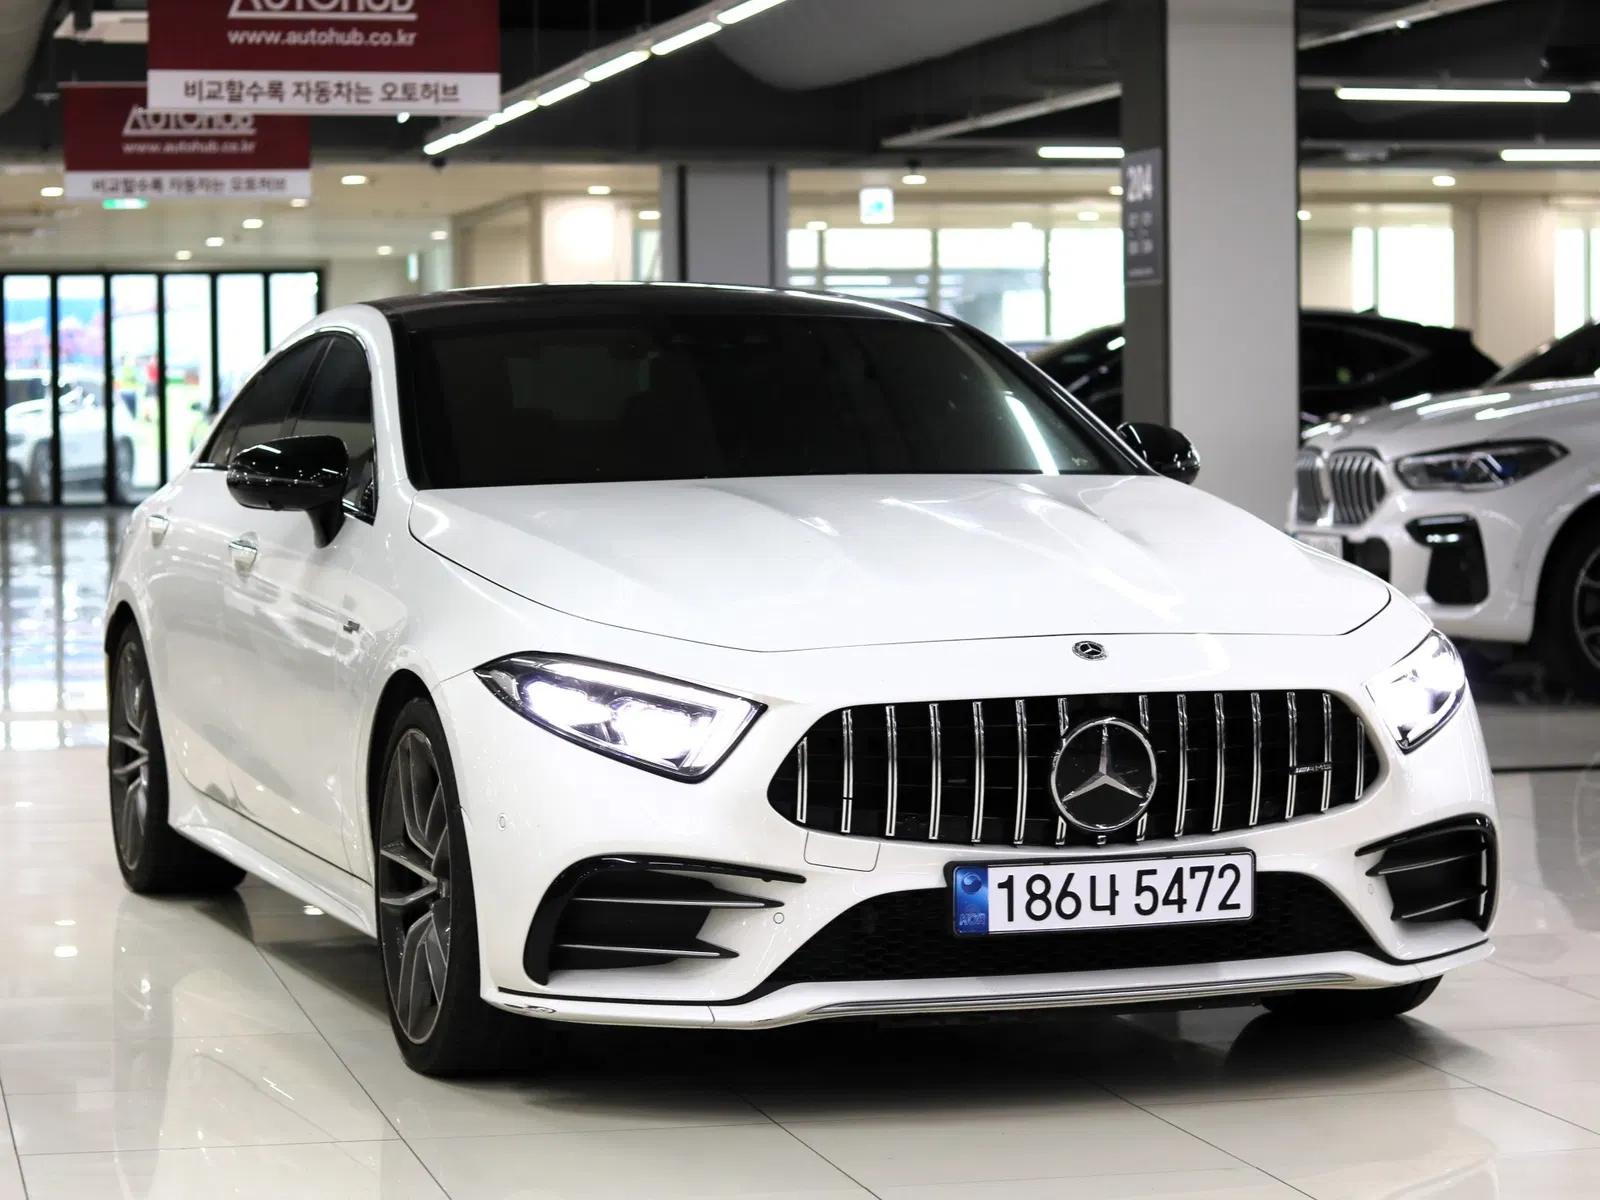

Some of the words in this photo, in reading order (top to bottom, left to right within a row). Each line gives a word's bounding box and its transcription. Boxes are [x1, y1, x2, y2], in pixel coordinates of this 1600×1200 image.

[227, 28, 417, 47] www.autohub.co.kr
[184, 79, 286, 103] 비교할수록
[292, 80, 373, 104] 자동차는
[380, 82, 460, 104] 오토허브
[997, 871, 1120, 922] 186나
[1133, 863, 1242, 916] 5472
